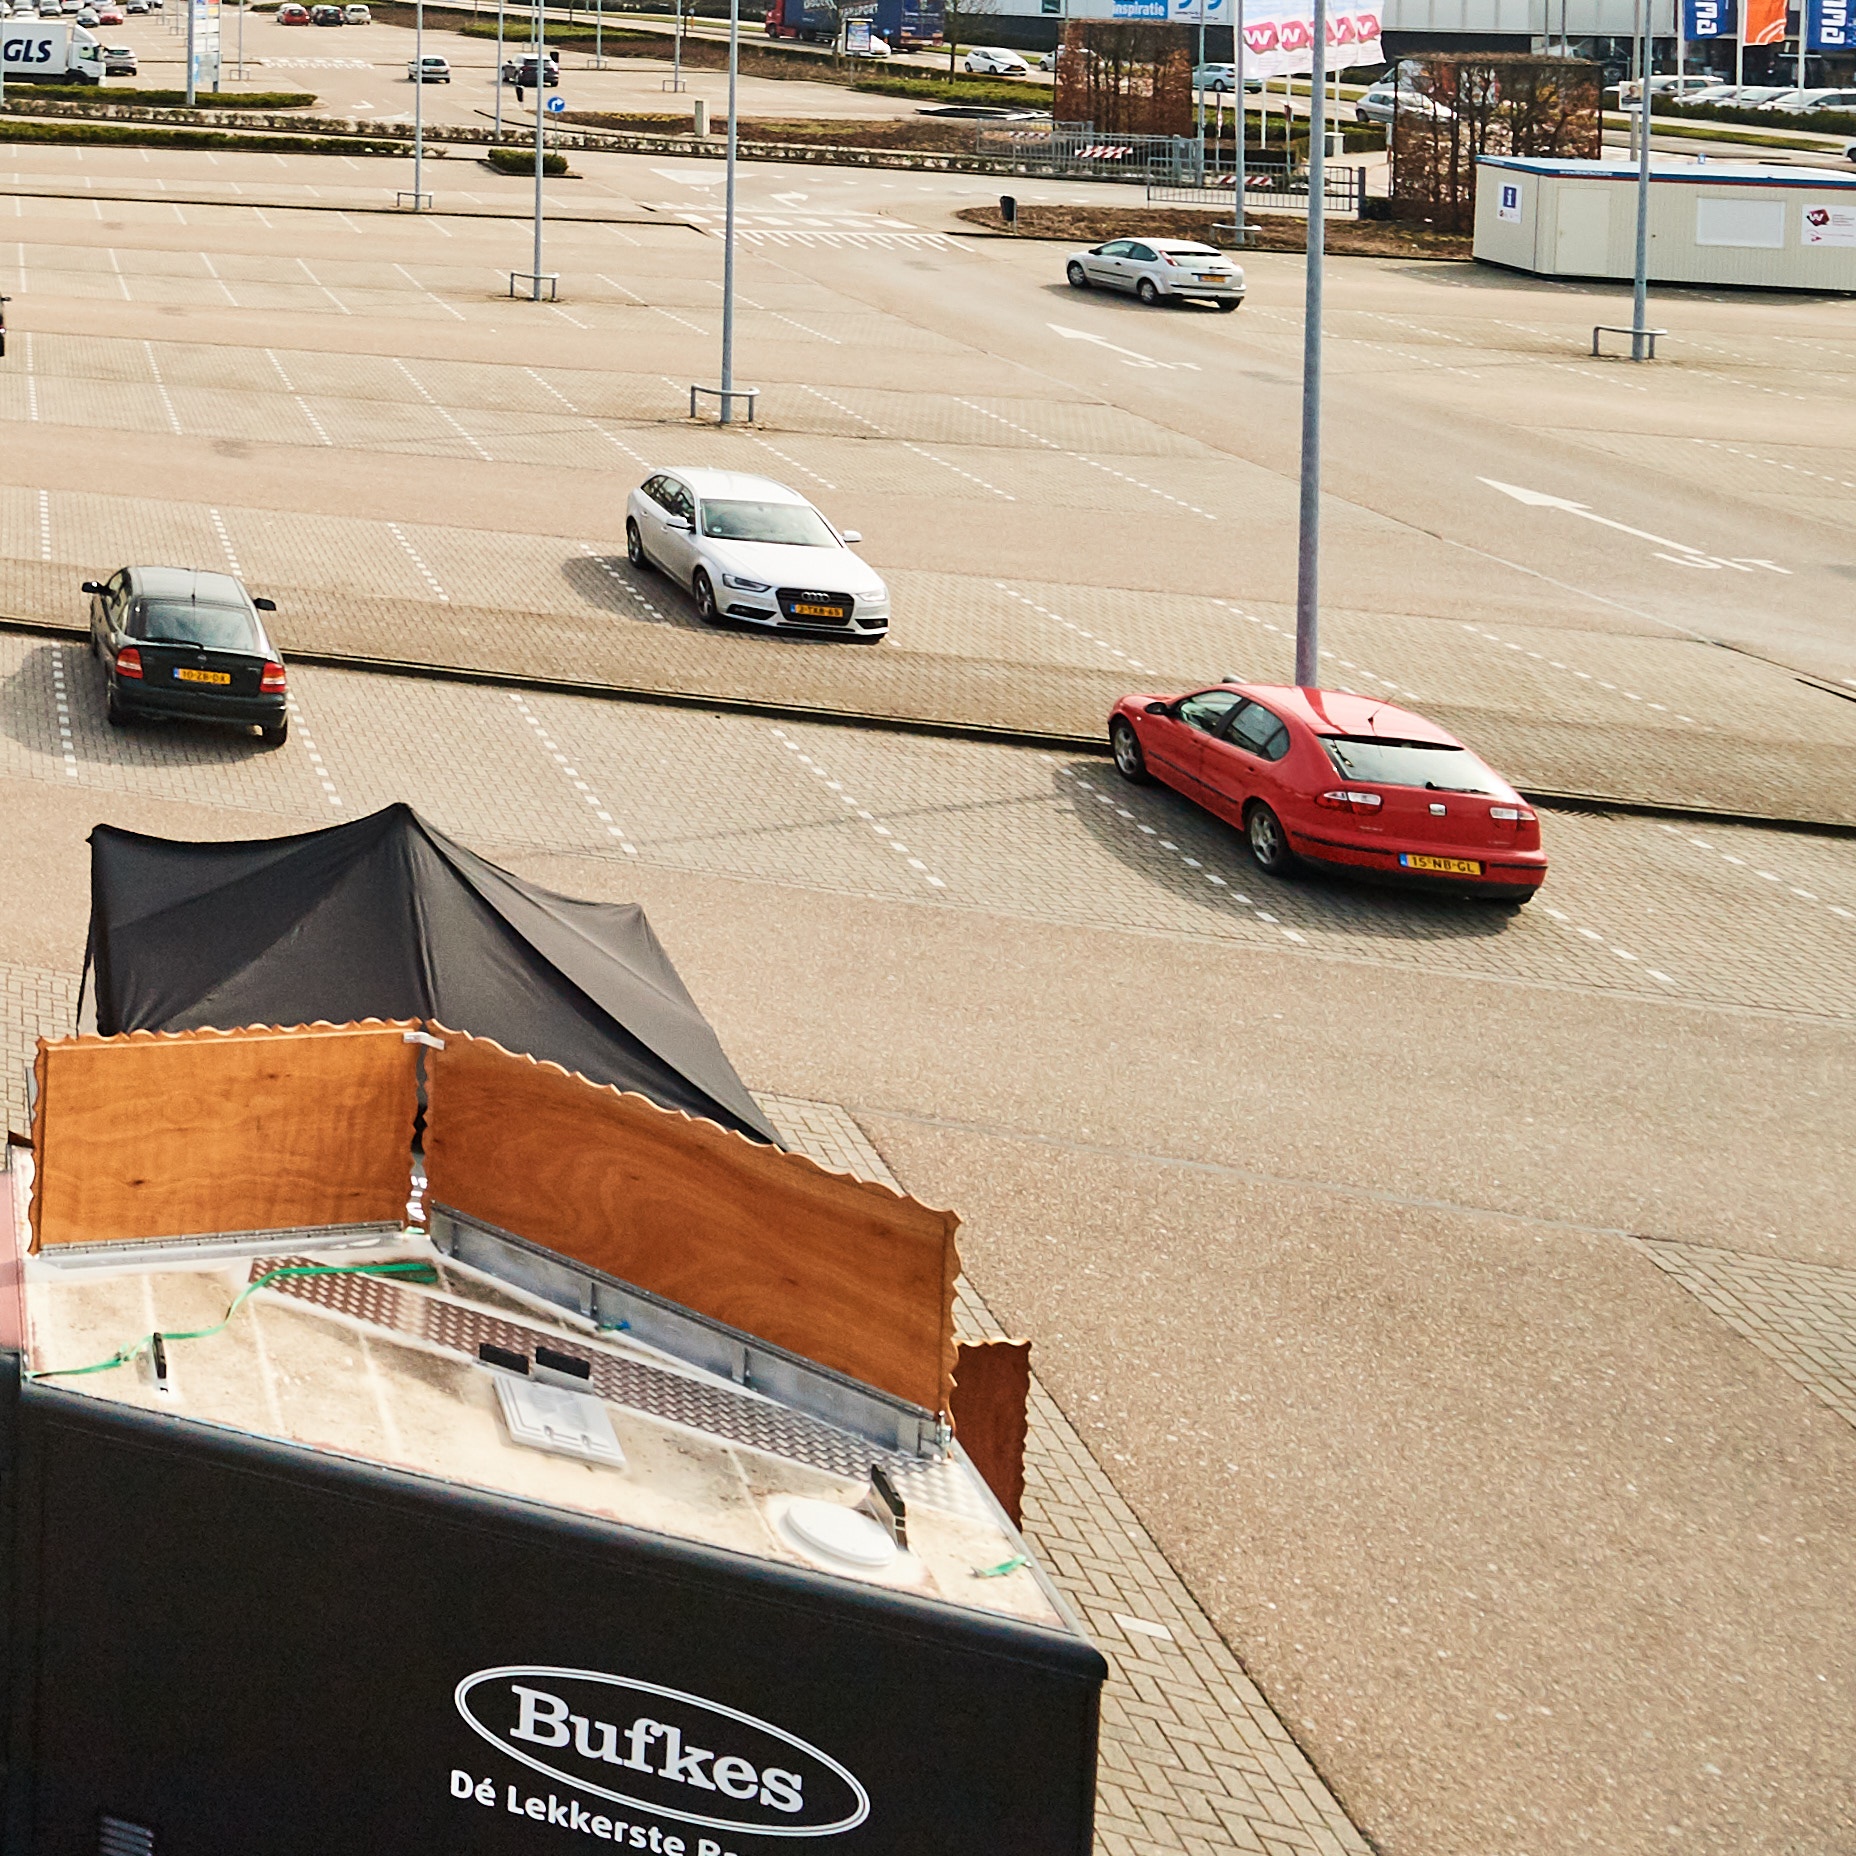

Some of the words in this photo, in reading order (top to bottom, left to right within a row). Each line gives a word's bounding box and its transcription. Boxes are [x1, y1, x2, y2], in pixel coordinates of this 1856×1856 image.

[3, 39, 52, 62] GLS
[1411, 855, 1475, 875] 15-NB-GL
[509, 1684, 804, 1814] Bufkes
[449, 1769, 496, 1807] Dé
[507, 1785, 687, 1856] Lekkerste
